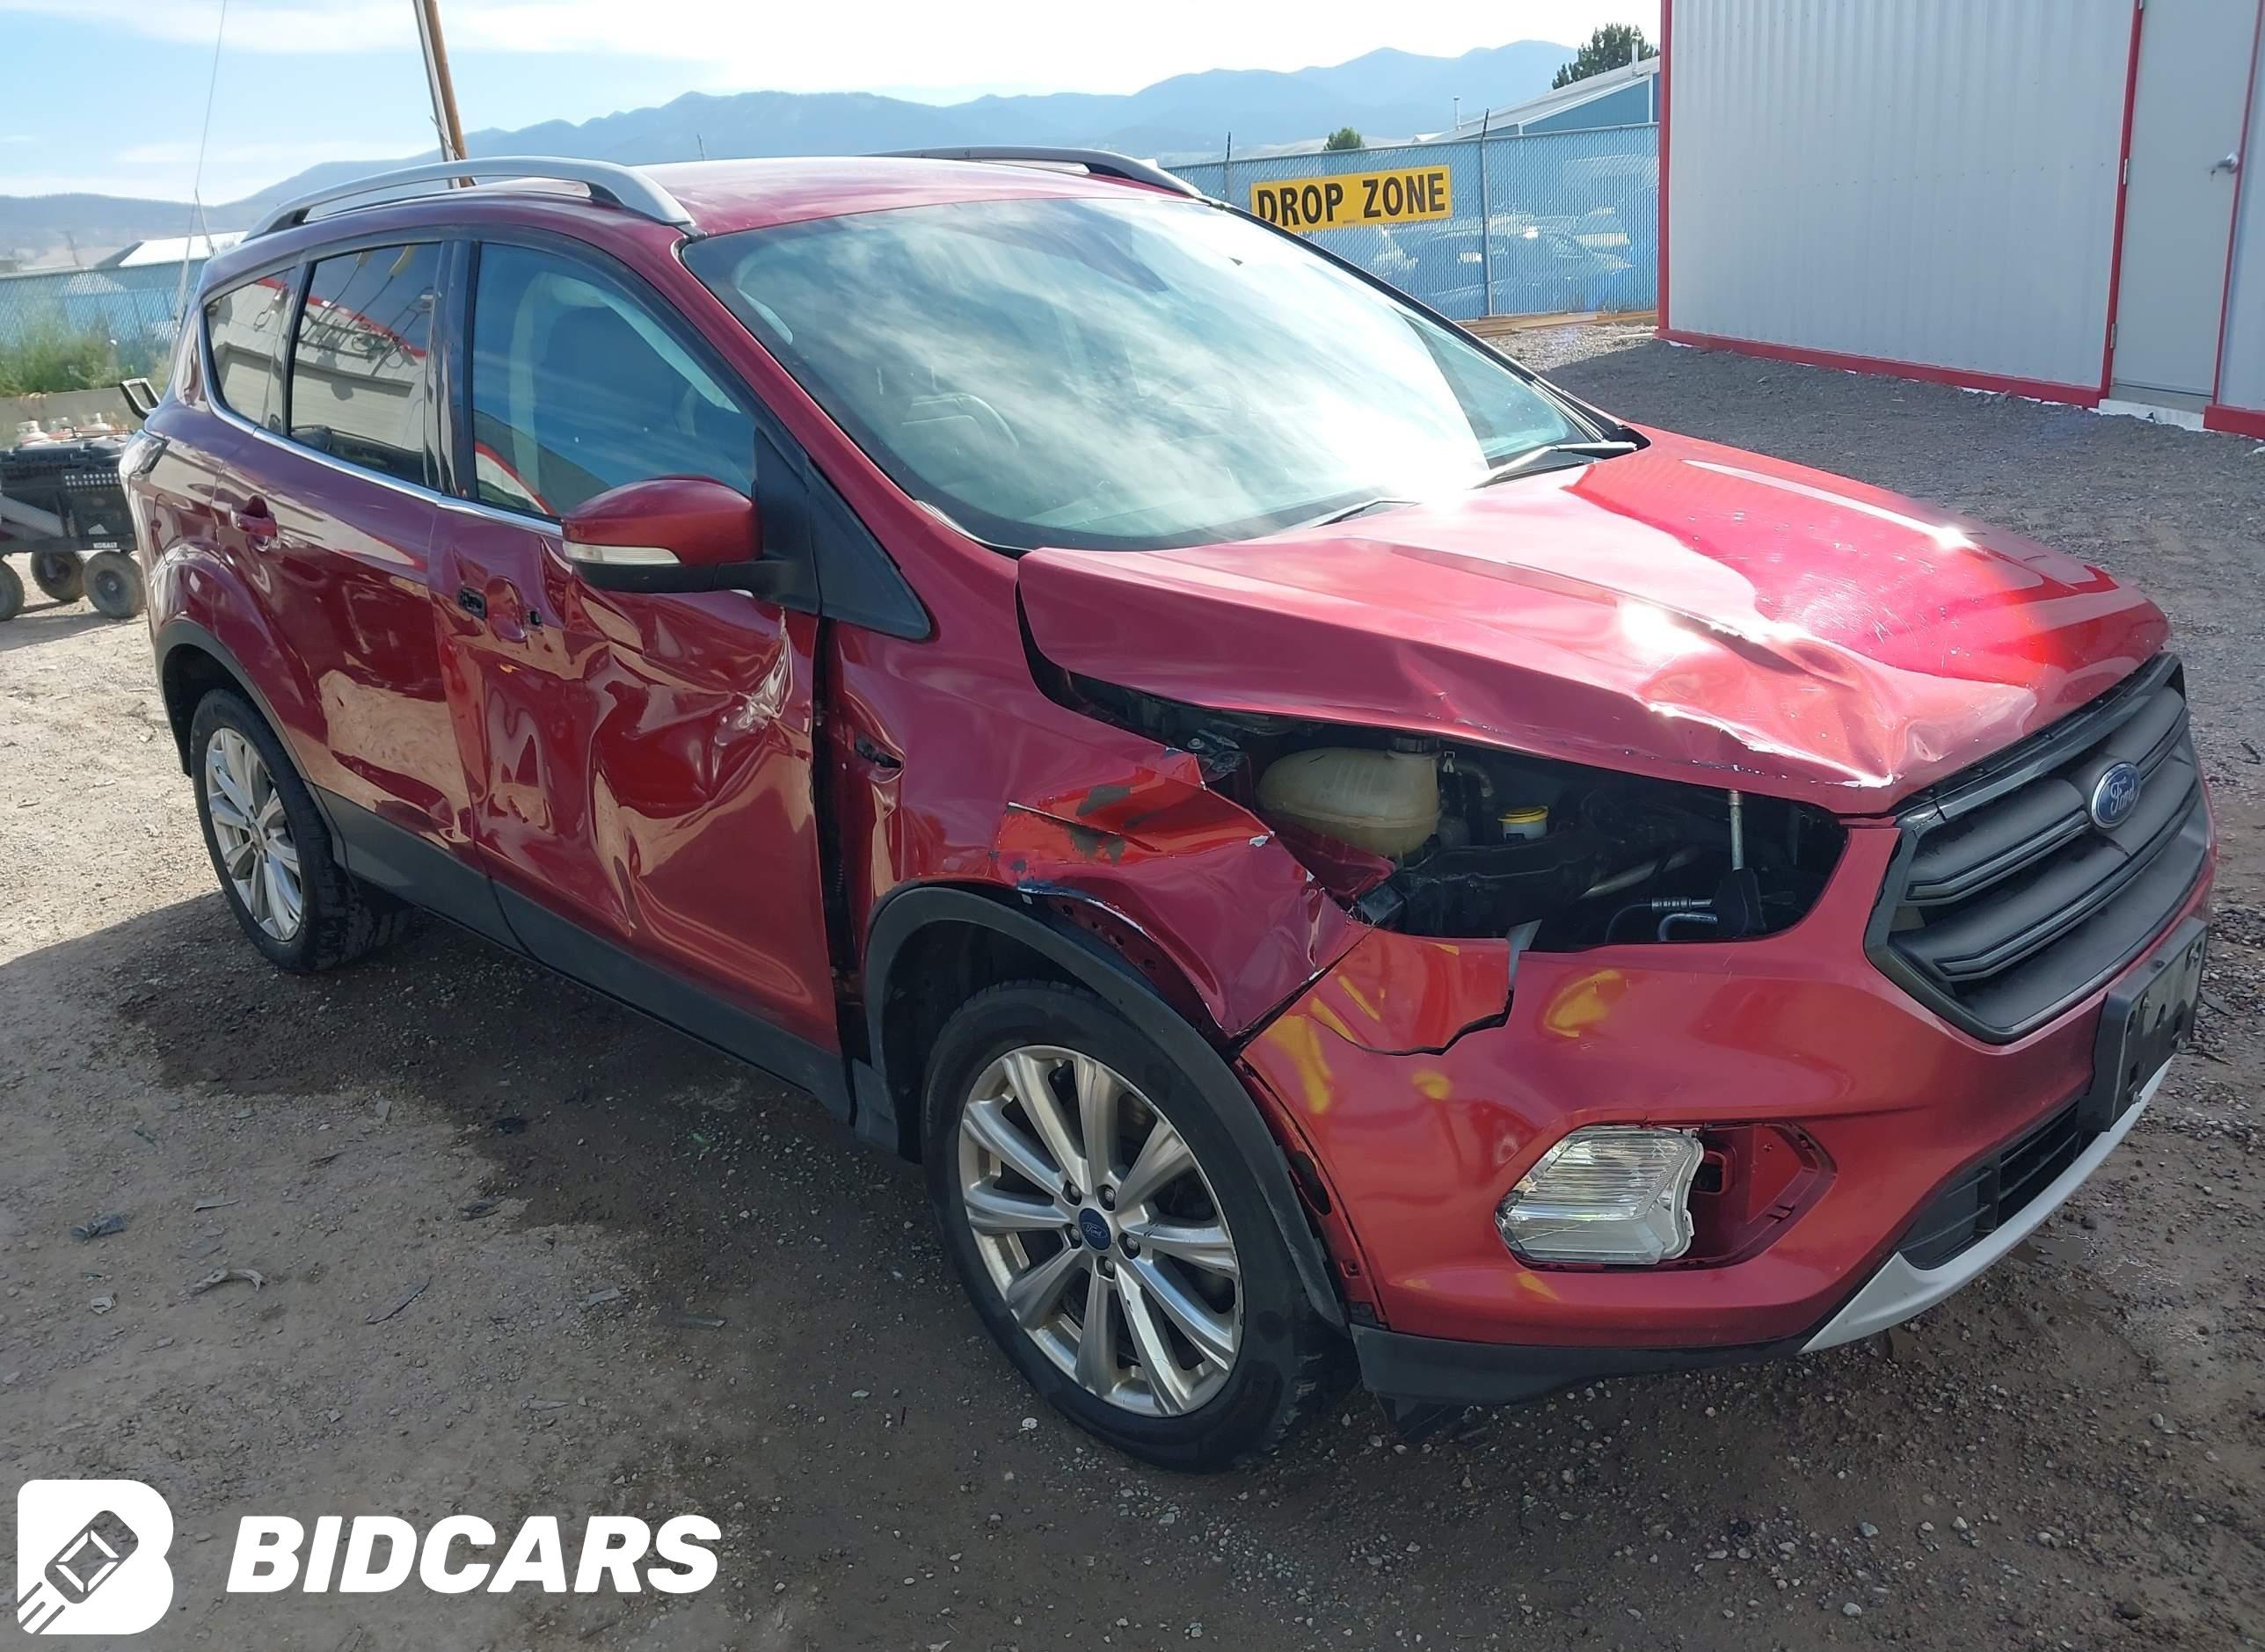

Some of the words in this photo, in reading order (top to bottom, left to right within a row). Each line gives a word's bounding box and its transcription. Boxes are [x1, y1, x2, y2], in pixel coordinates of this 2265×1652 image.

[1257, 183, 1344, 227] DROP
[1363, 172, 1446, 218] ZONE
[2110, 775, 2135, 816] Ford
